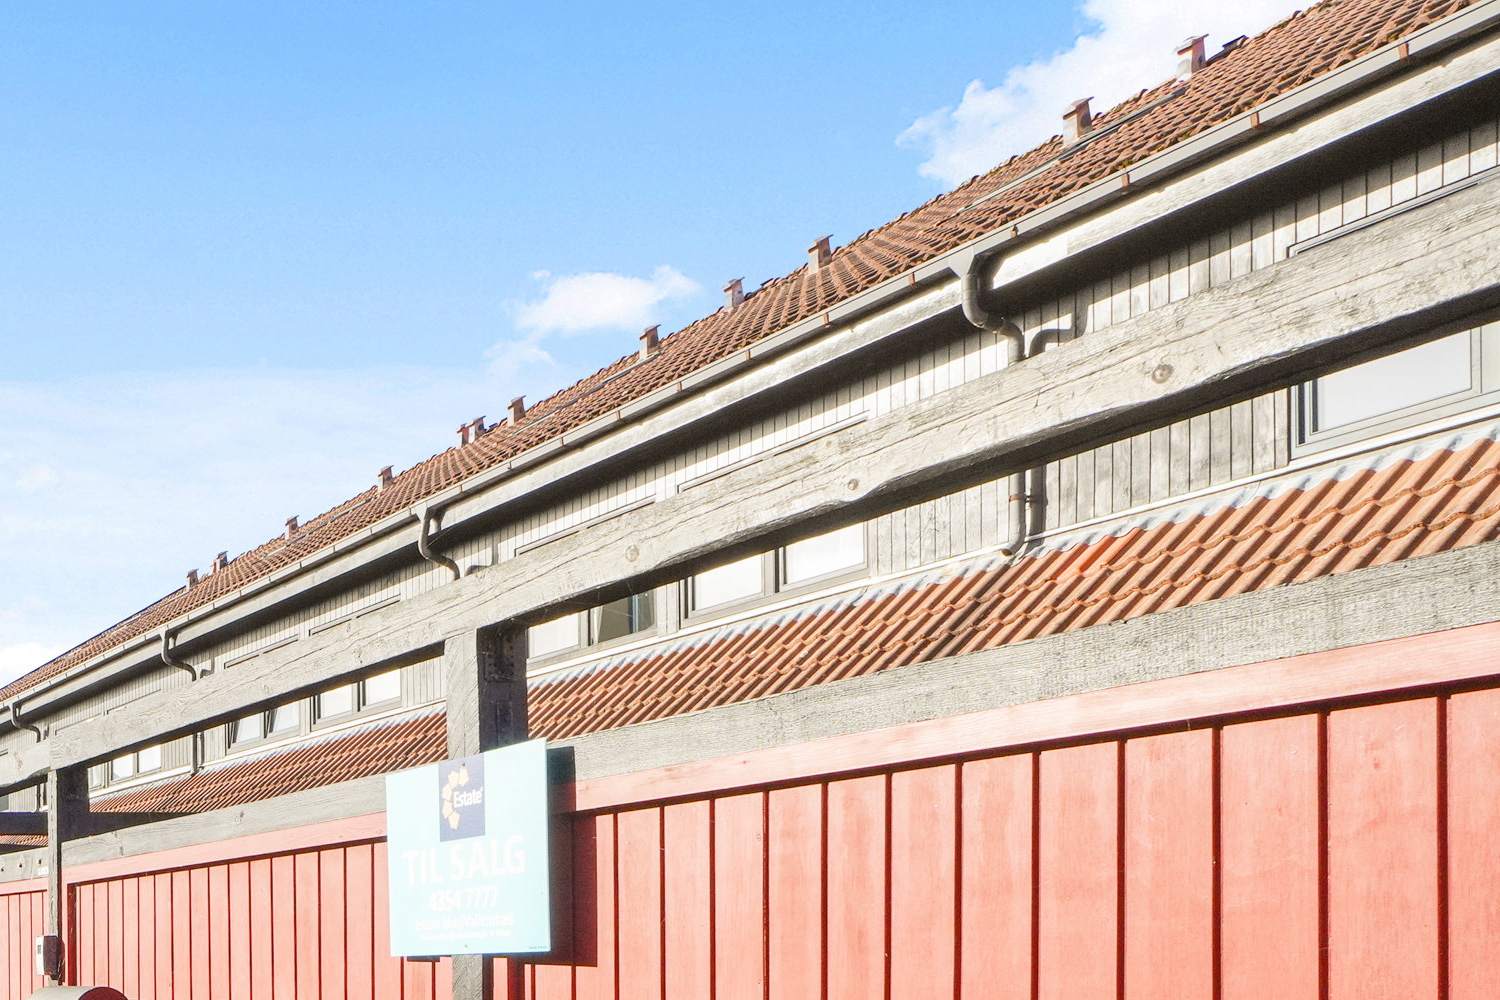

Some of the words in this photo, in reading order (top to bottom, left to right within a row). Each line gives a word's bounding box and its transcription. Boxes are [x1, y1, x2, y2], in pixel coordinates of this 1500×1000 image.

[453, 789, 483, 808] Estate
[403, 848, 444, 886] TIL
[450, 835, 526, 881] SALG
[428, 889, 461, 912] 4354
[465, 885, 499, 909] 7777
